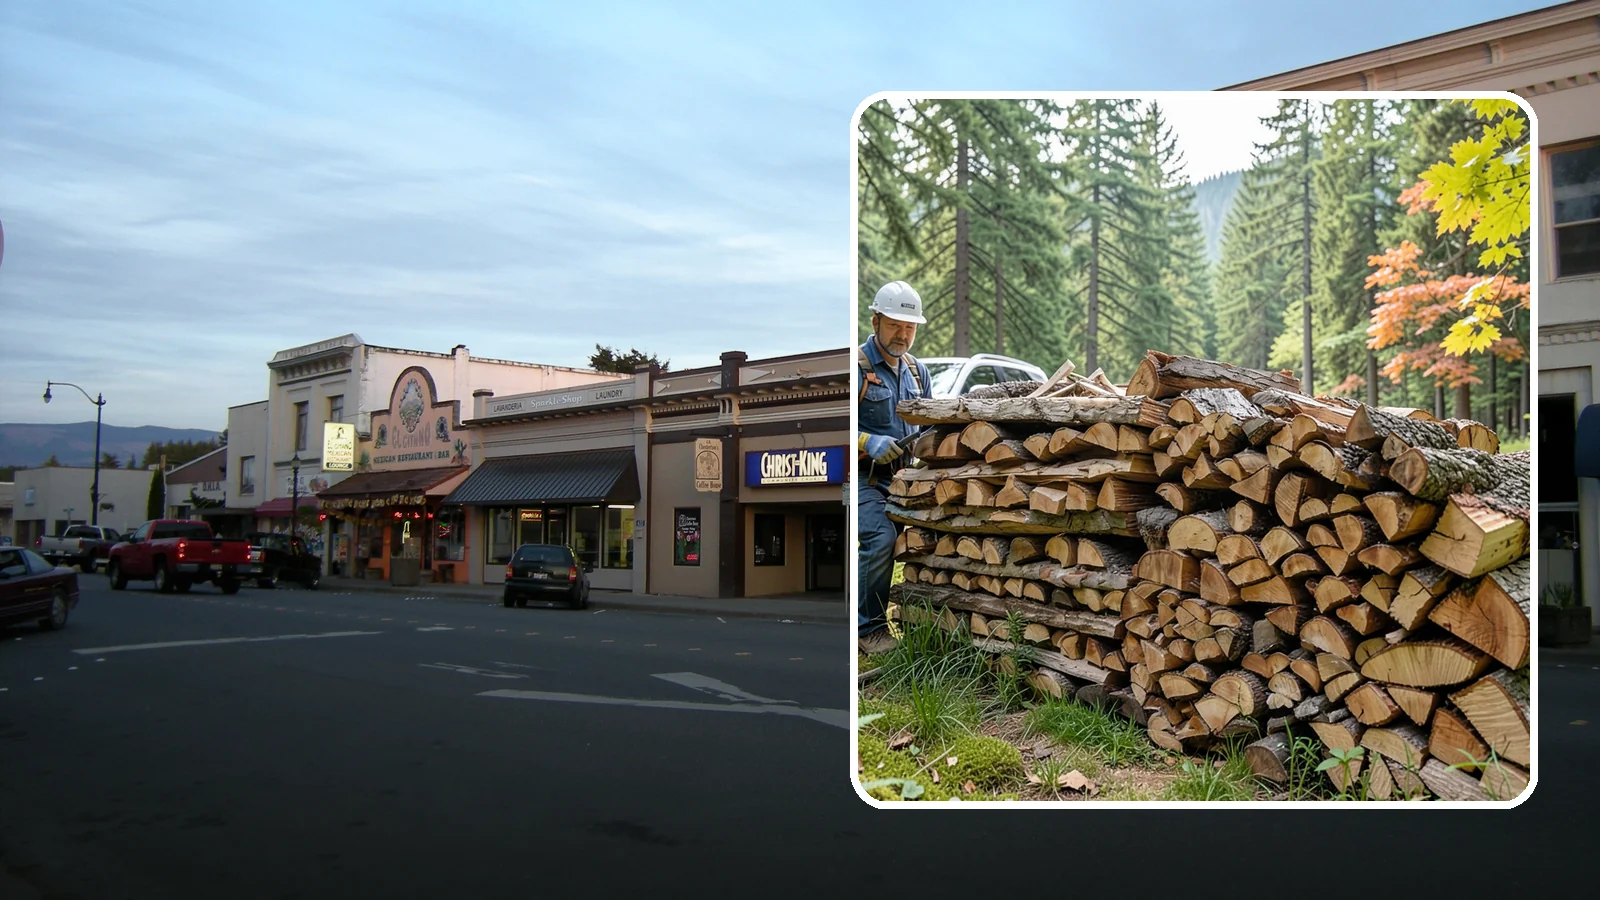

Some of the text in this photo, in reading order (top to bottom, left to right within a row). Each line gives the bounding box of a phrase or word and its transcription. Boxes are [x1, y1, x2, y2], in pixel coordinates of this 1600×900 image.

[562, 393, 583, 406] Shop
[595, 388, 624, 400] LAUNDRY
[493, 401, 523, 413] LAVANDERIA
[373, 450, 450, 464] MEXICAN RESTAURANT BAR
